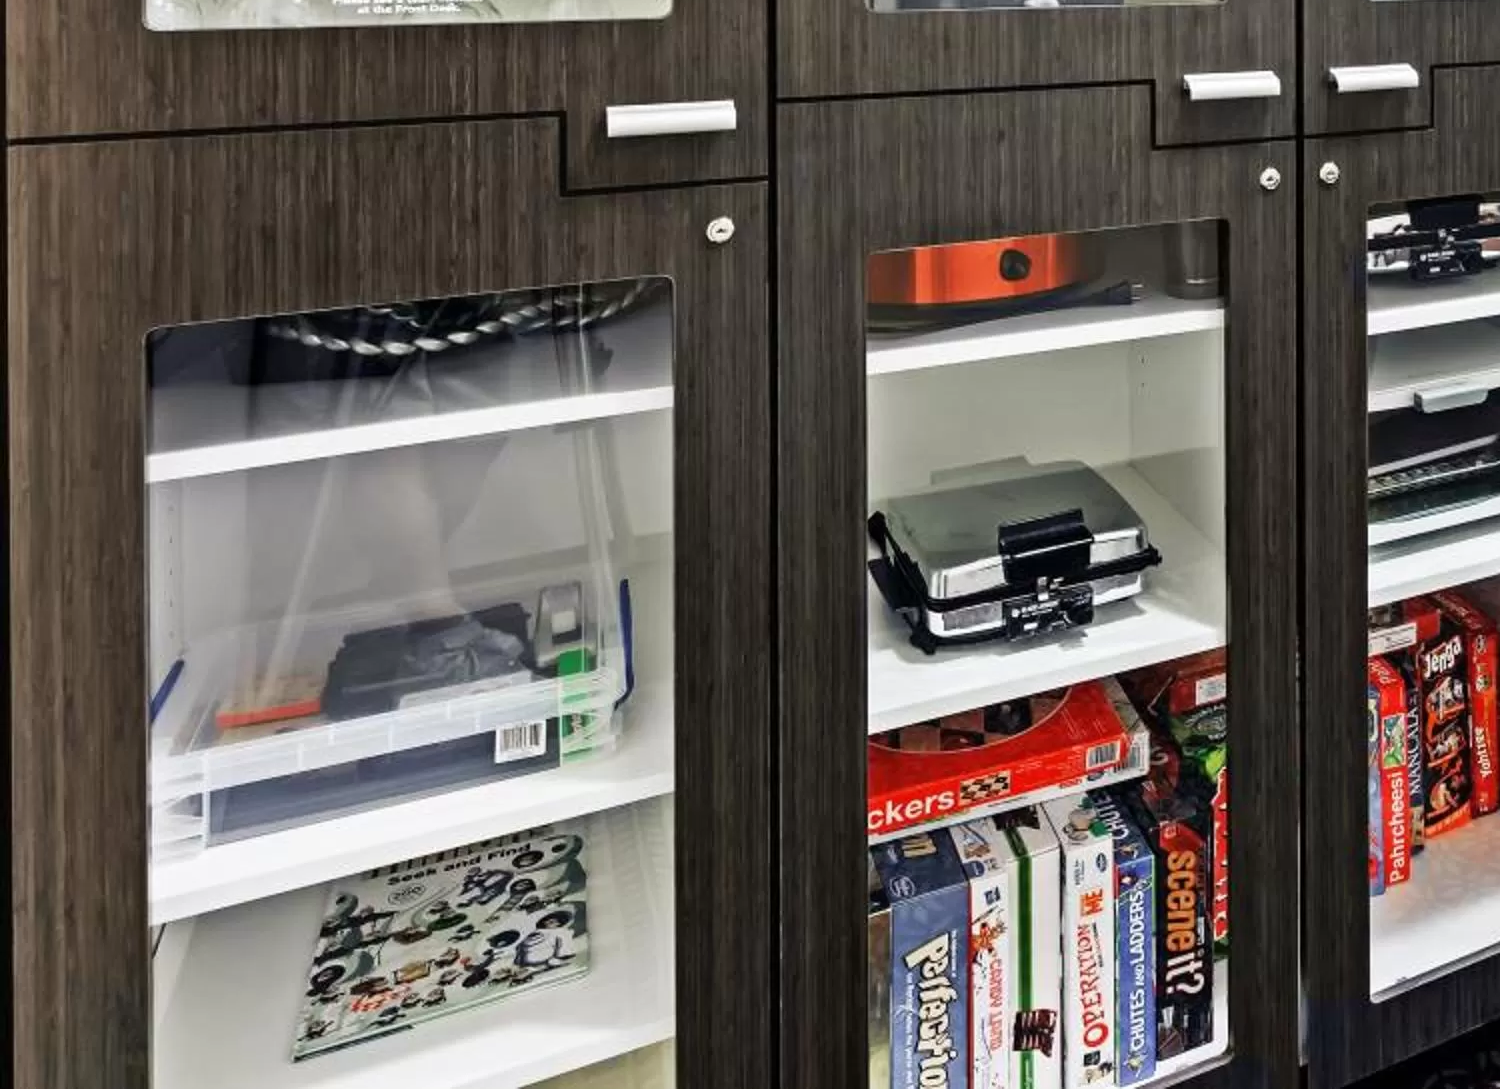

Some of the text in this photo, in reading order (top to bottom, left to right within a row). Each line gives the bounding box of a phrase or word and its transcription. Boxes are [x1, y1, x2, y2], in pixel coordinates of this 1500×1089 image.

[1424, 635, 1462, 679] Jenga
[1407, 704, 1423, 796] MANCALA
[868, 789, 955, 829] ckers
[1389, 772, 1405, 882] Pahrcheesi
[388, 867, 437, 886] Seek
[443, 855, 481, 872] and
[1167, 851, 1196, 952] scene
[1129, 890, 1146, 965] LADDERS
[904, 932, 958, 1089] Perfectio
[1077, 923, 1109, 1048] OPERATION
[1129, 991, 1146, 1051] CHUTES
